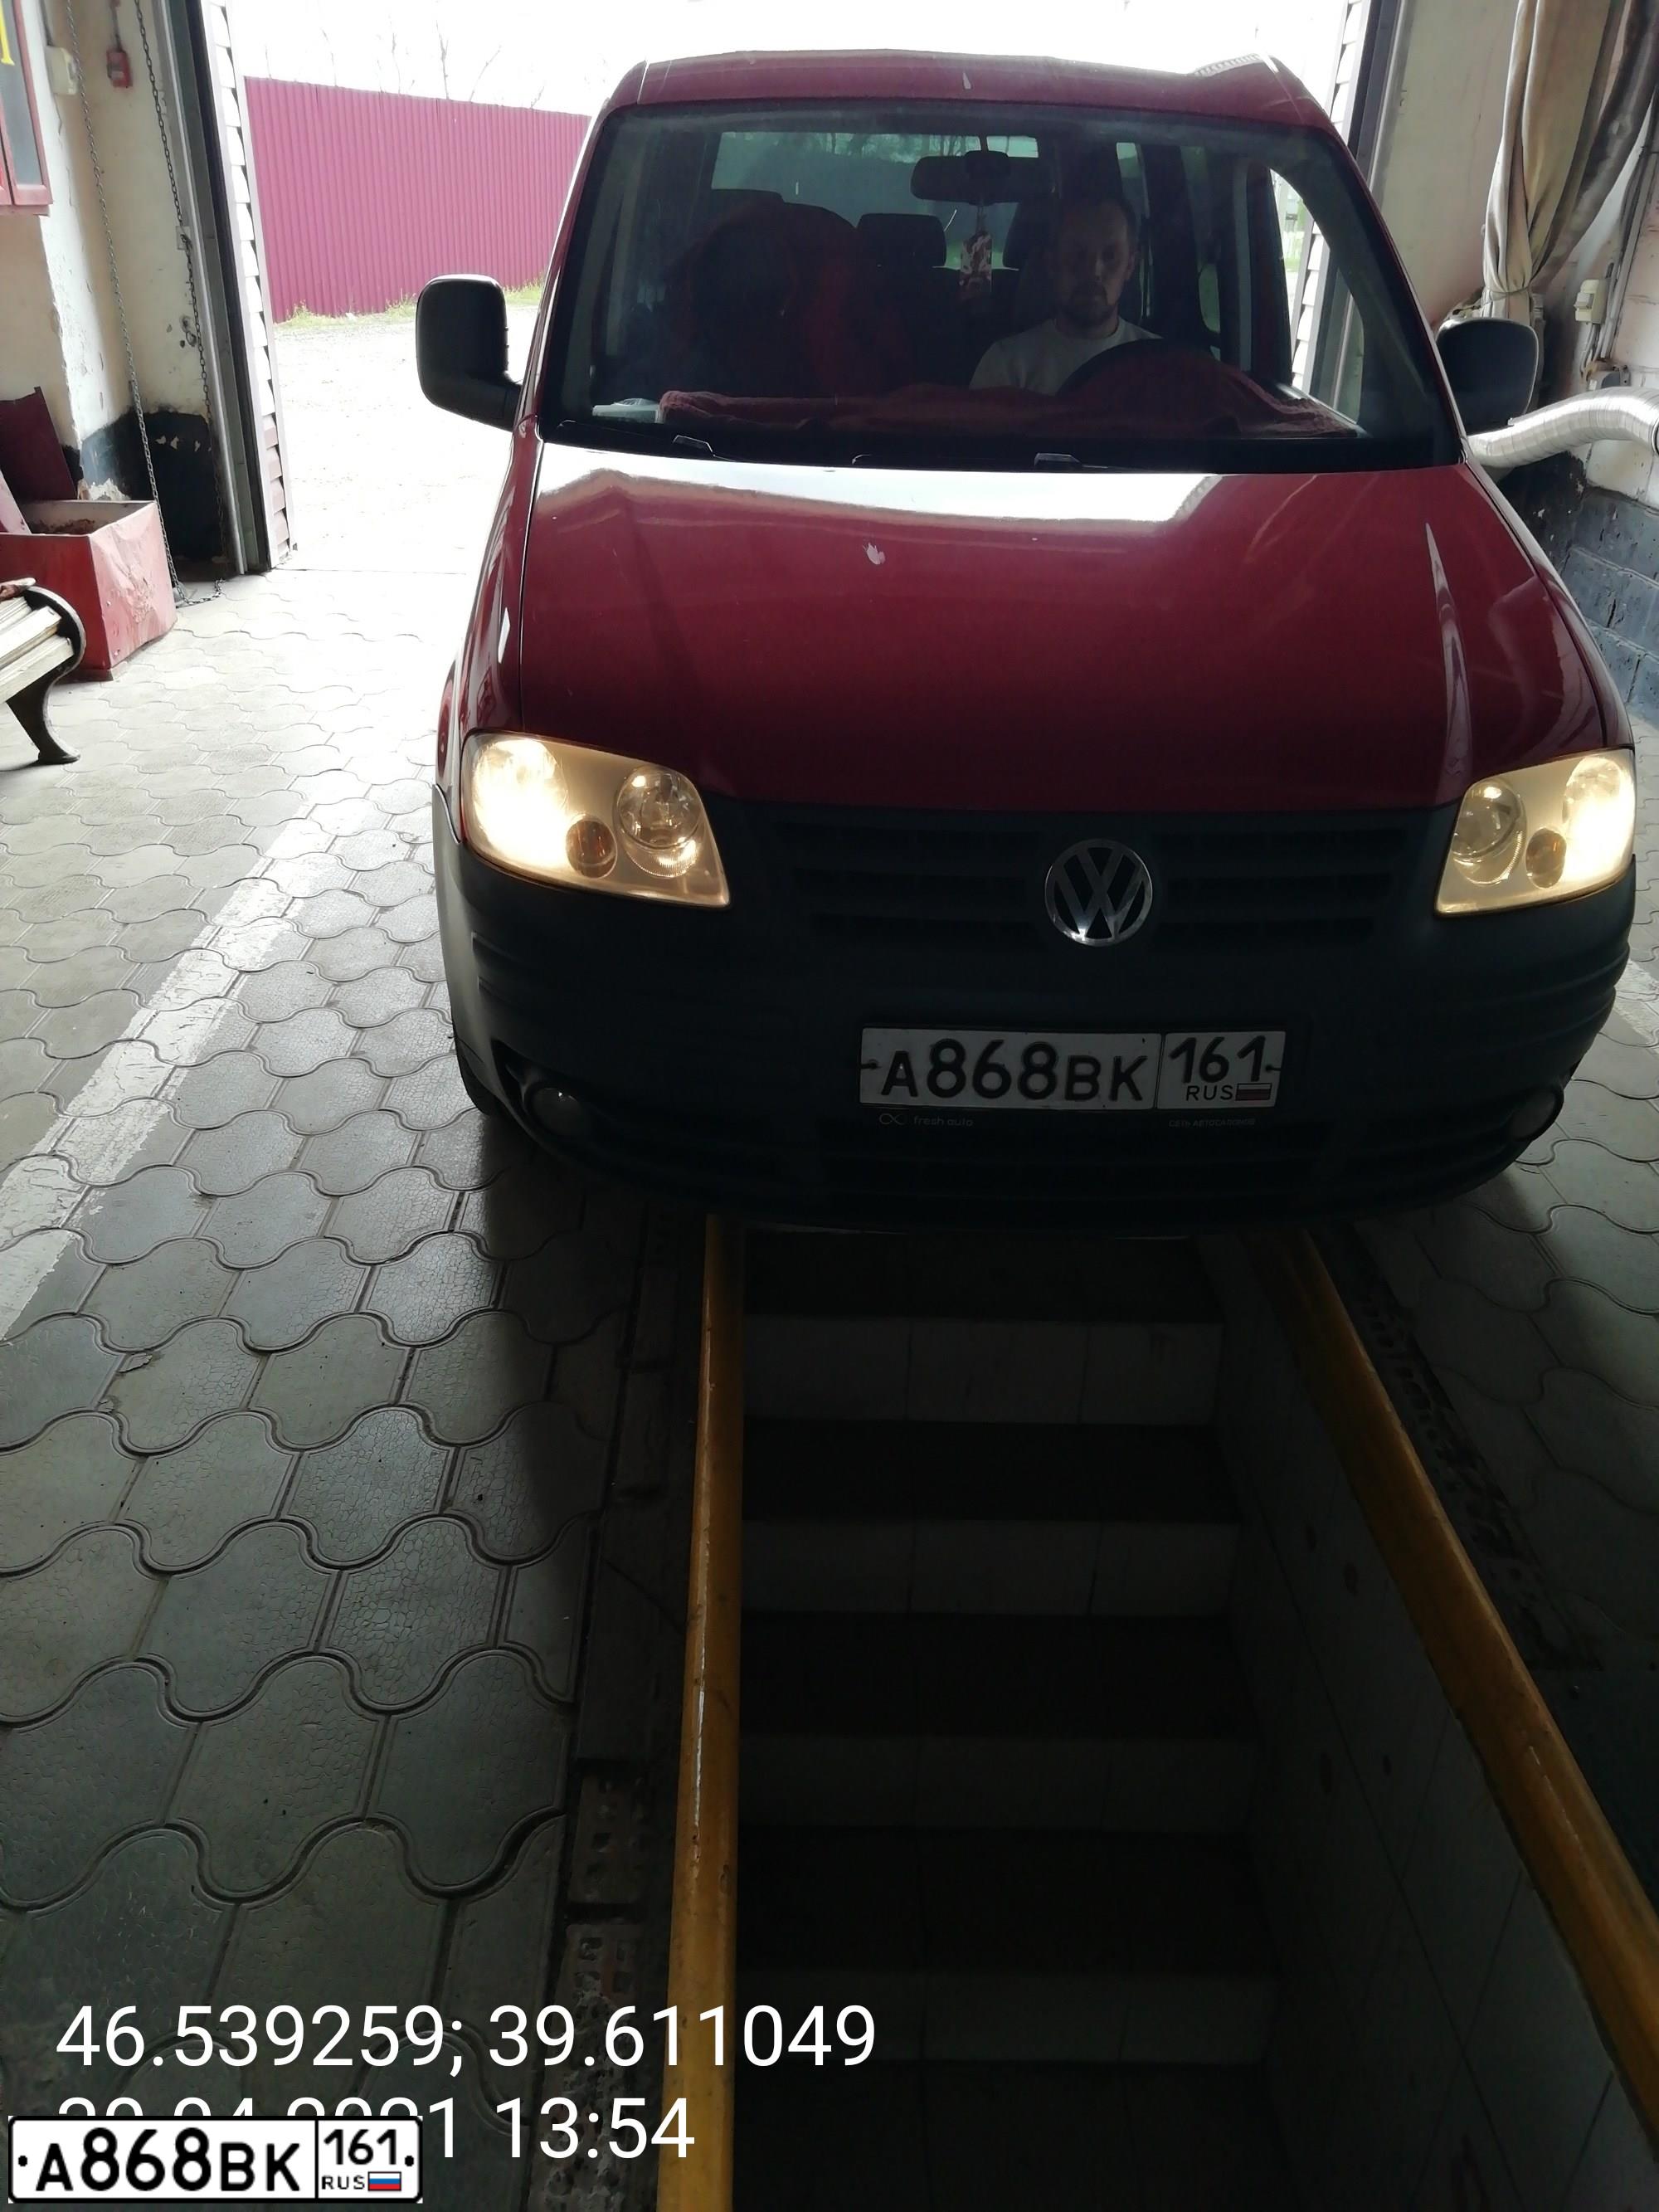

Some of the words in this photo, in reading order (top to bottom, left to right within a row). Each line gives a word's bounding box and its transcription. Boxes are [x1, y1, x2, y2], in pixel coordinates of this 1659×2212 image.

[1169, 1035, 1266, 1084] 161
[1185, 1084, 1233, 1102] RUS
[913, 1115, 945, 1127] fresh
[946, 1117, 974, 1128] auto
